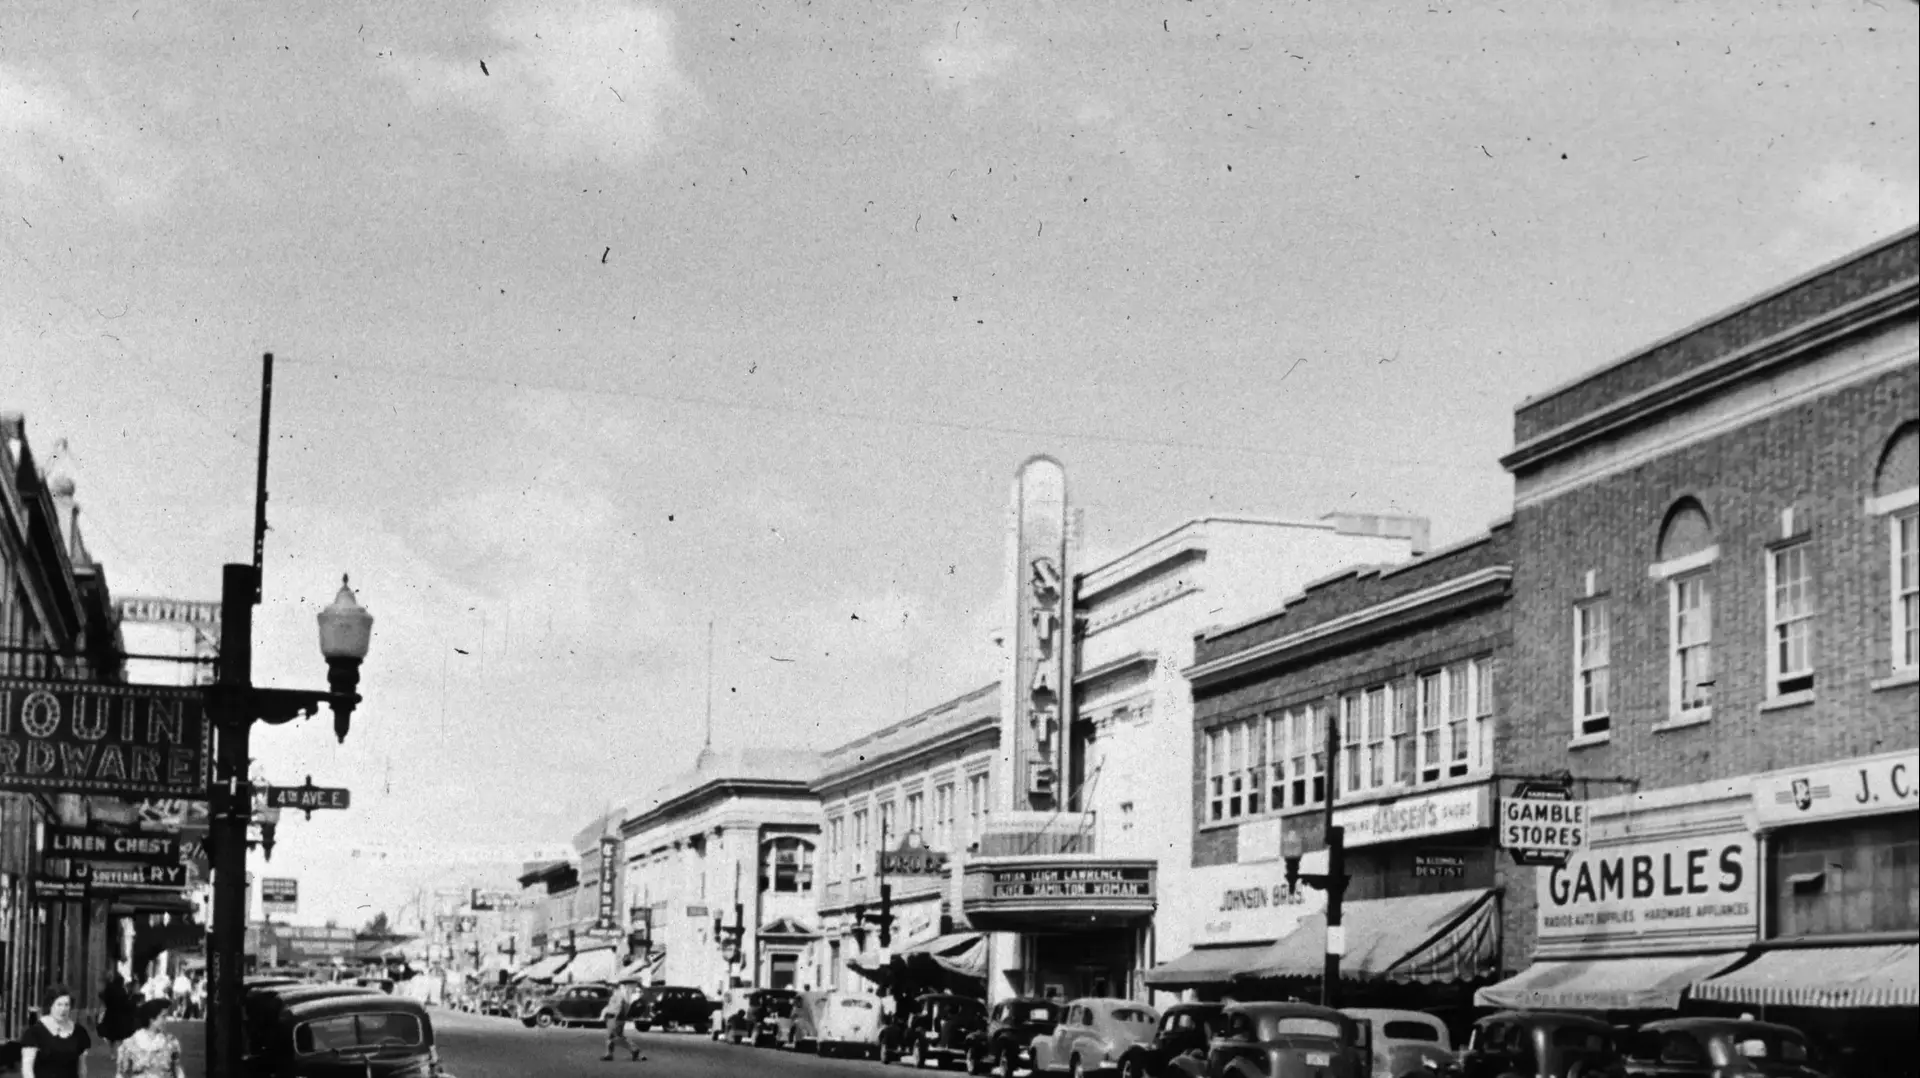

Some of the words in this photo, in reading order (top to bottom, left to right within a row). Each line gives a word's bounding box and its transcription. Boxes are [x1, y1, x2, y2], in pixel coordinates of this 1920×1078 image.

[1029, 556, 1059, 803] STATE
[276, 790, 298, 804] 4TH
[1507, 803, 1583, 824] GAMBLE
[53, 835, 107, 852] LINEN
[114, 837, 172, 855] CHEST
[1508, 825, 1582, 847] STORES
[1032, 870, 1058, 882] LEIGH
[1064, 869, 1123, 881] LAWRENCE
[1415, 866, 1464, 877] DENTIST
[1549, 844, 1744, 906] GAMBLES
[1219, 887, 1268, 911] JOHNSON
